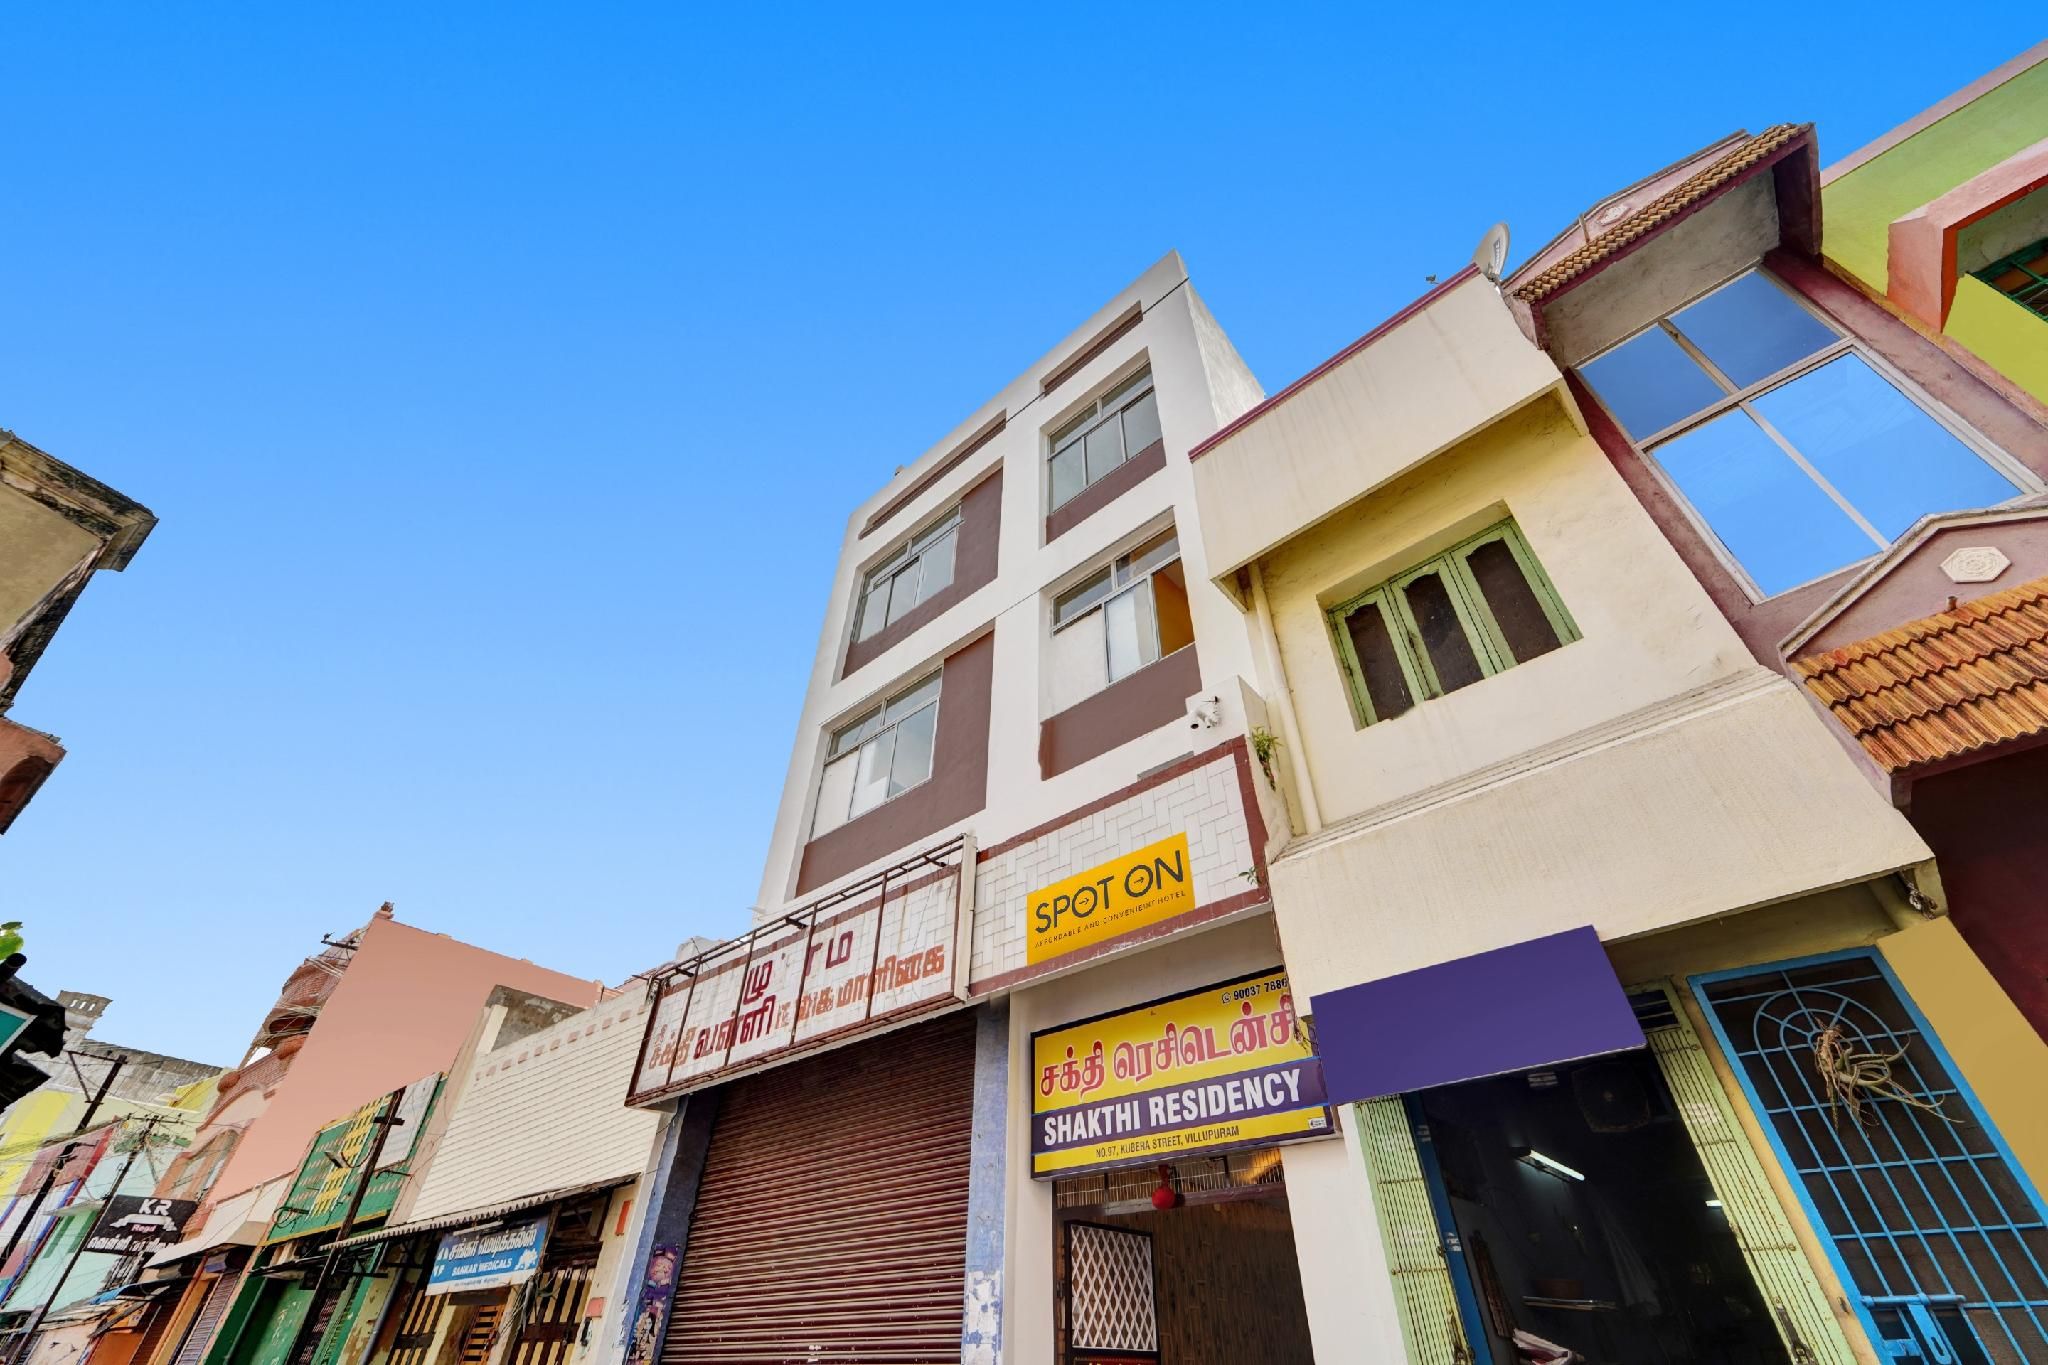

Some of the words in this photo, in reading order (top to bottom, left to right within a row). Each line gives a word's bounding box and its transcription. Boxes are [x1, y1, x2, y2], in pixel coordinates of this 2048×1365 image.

[1034, 926, 1082, 949] AFFORDABLE
[1084, 920, 1101, 932] AND
[1103, 900, 1156, 926] CONVENIENT
[1157, 890, 1186, 906] HOTEL
[1035, 876, 1115, 934] SPOT
[1124, 850, 1184, 898] ON
[1233, 984, 1261, 1000] 90037
[1040, 1040, 1106, 1098] சக்தி
[1044, 1101, 1141, 1146] SHAKTHI
[1150, 1069, 1301, 1127] RESIDENCY
[1120, 1142, 1150, 1154] KUBERA
[1185, 1126, 1240, 1144] VILLUPURAM
[478, 1258, 513, 1273] MEDICALS
